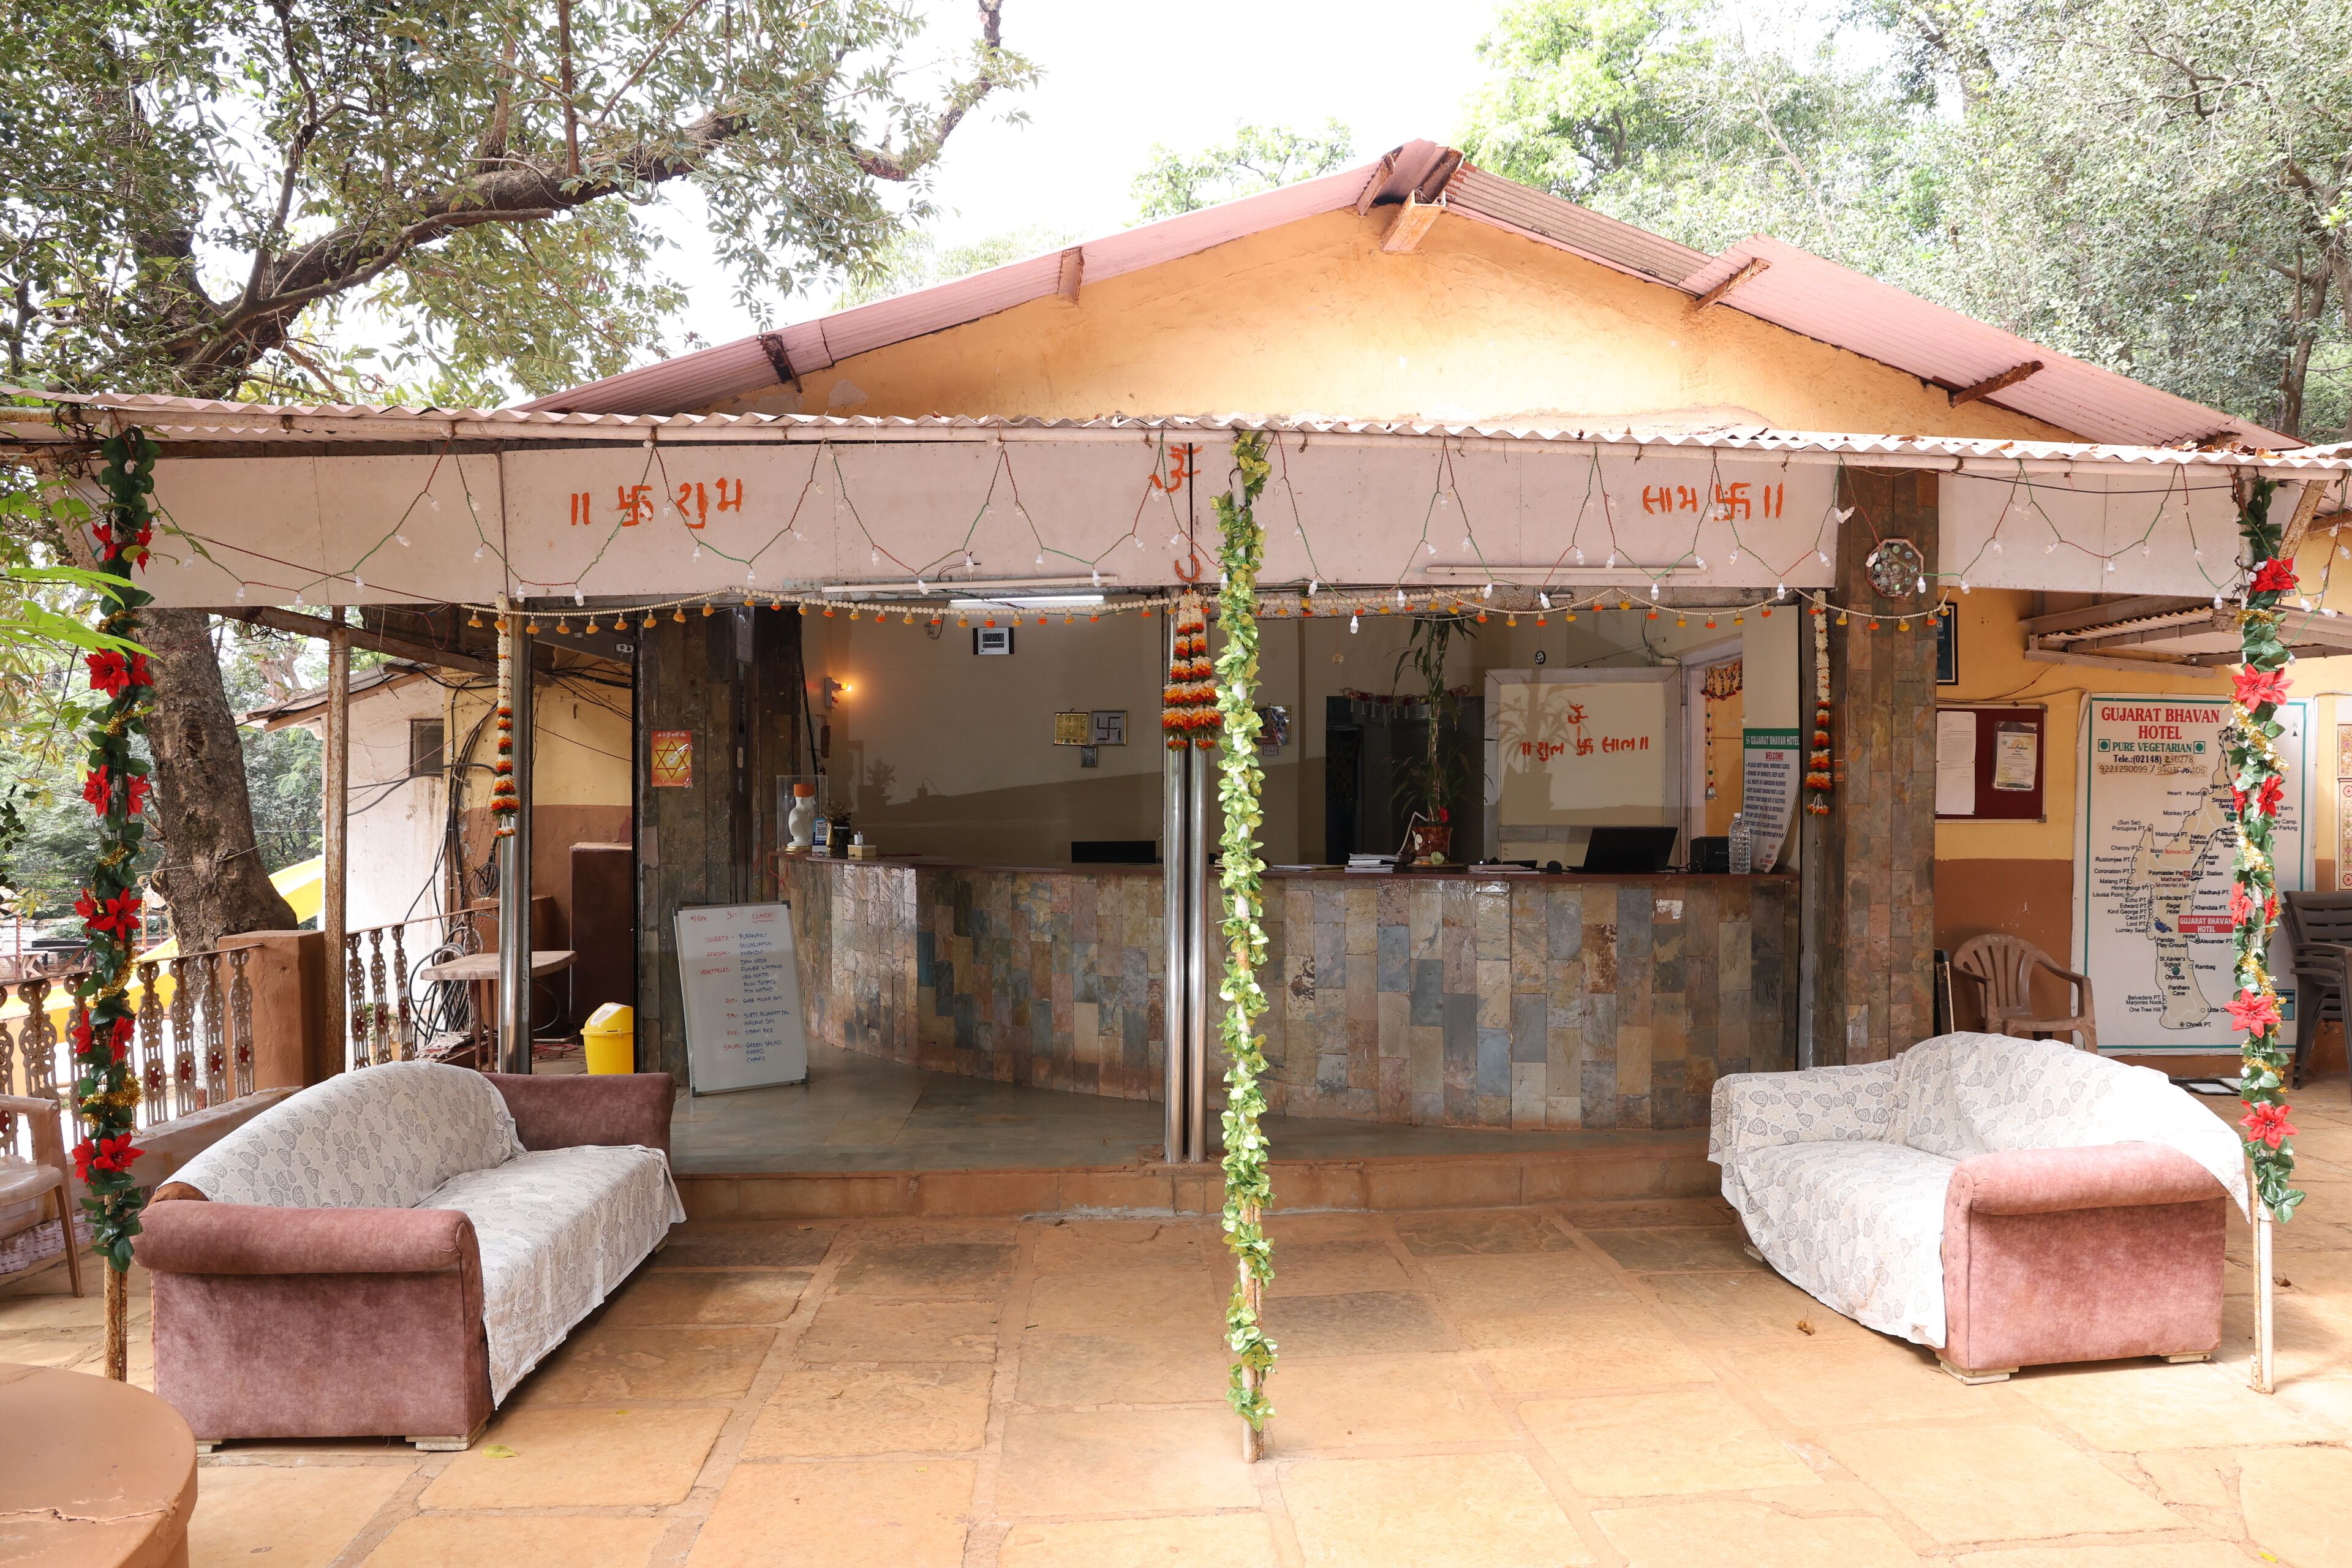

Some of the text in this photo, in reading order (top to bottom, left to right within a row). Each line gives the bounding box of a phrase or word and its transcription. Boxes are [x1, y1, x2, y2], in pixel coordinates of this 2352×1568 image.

[2101, 706, 2220, 723] GUJARAT BHAVAN
[2138, 725, 2182, 740] HOTEL
[1751, 735, 1800, 745] GUJARAT BHAVAN HOTEL
[2113, 742, 2192, 753] PURE VEGETARIAN
[1765, 752, 1784, 760] WELCOME
[2100, 764, 2148, 773] 9221290099
